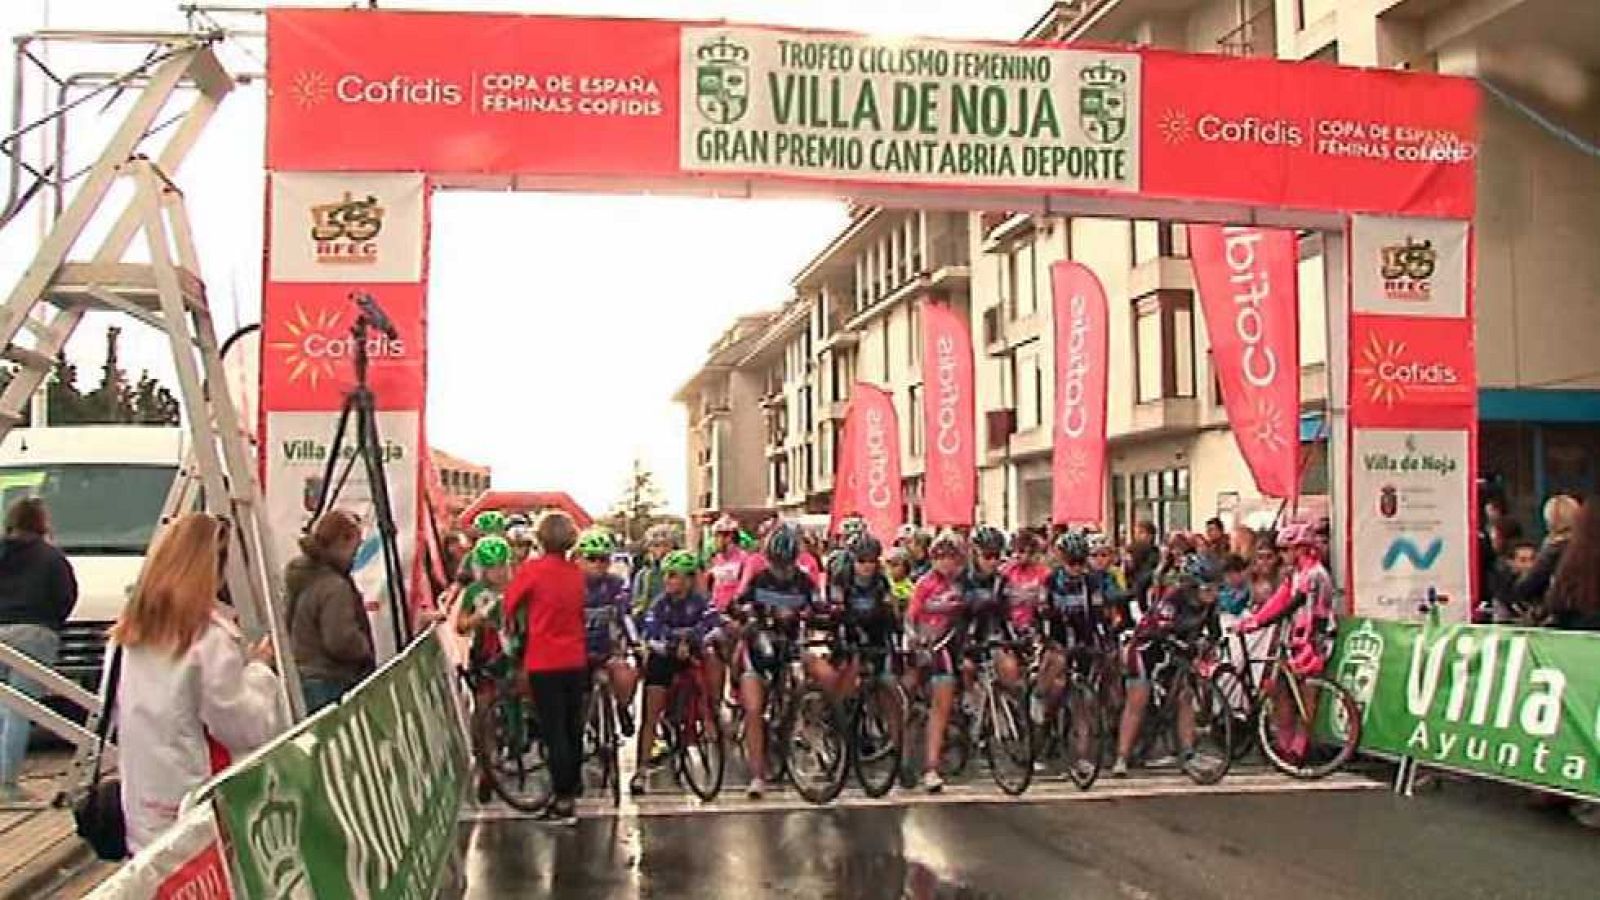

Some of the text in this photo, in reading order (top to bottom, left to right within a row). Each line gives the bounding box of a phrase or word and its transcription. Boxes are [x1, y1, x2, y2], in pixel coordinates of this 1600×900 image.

[777, 41, 1051, 83] TROFEO CICLISMO FEMENINO
[336, 74, 462, 105] Cofidis
[483, 74, 659, 95] COPA DE ESPAÑA
[578, 98, 662, 116] COFIDIS
[768, 72, 1061, 139] VILLA DE NOJA
[1198, 114, 1302, 148] Cofidis
[1318, 121, 1365, 138] COPA
[1370, 124, 1391, 141] DE
[699, 129, 1126, 180] GRAN PREMIO CANTABRIA DEPORTE
[303, 333, 406, 358] Cofdis
[1379, 361, 1457, 383] Cofidis
[283, 440, 326, 460] Villa
[1363, 454, 1397, 470] Villa
[1400, 454, 1418, 470] de
[1407, 627, 1567, 736] Villa
[1408, 720, 1587, 780] Ayunta
